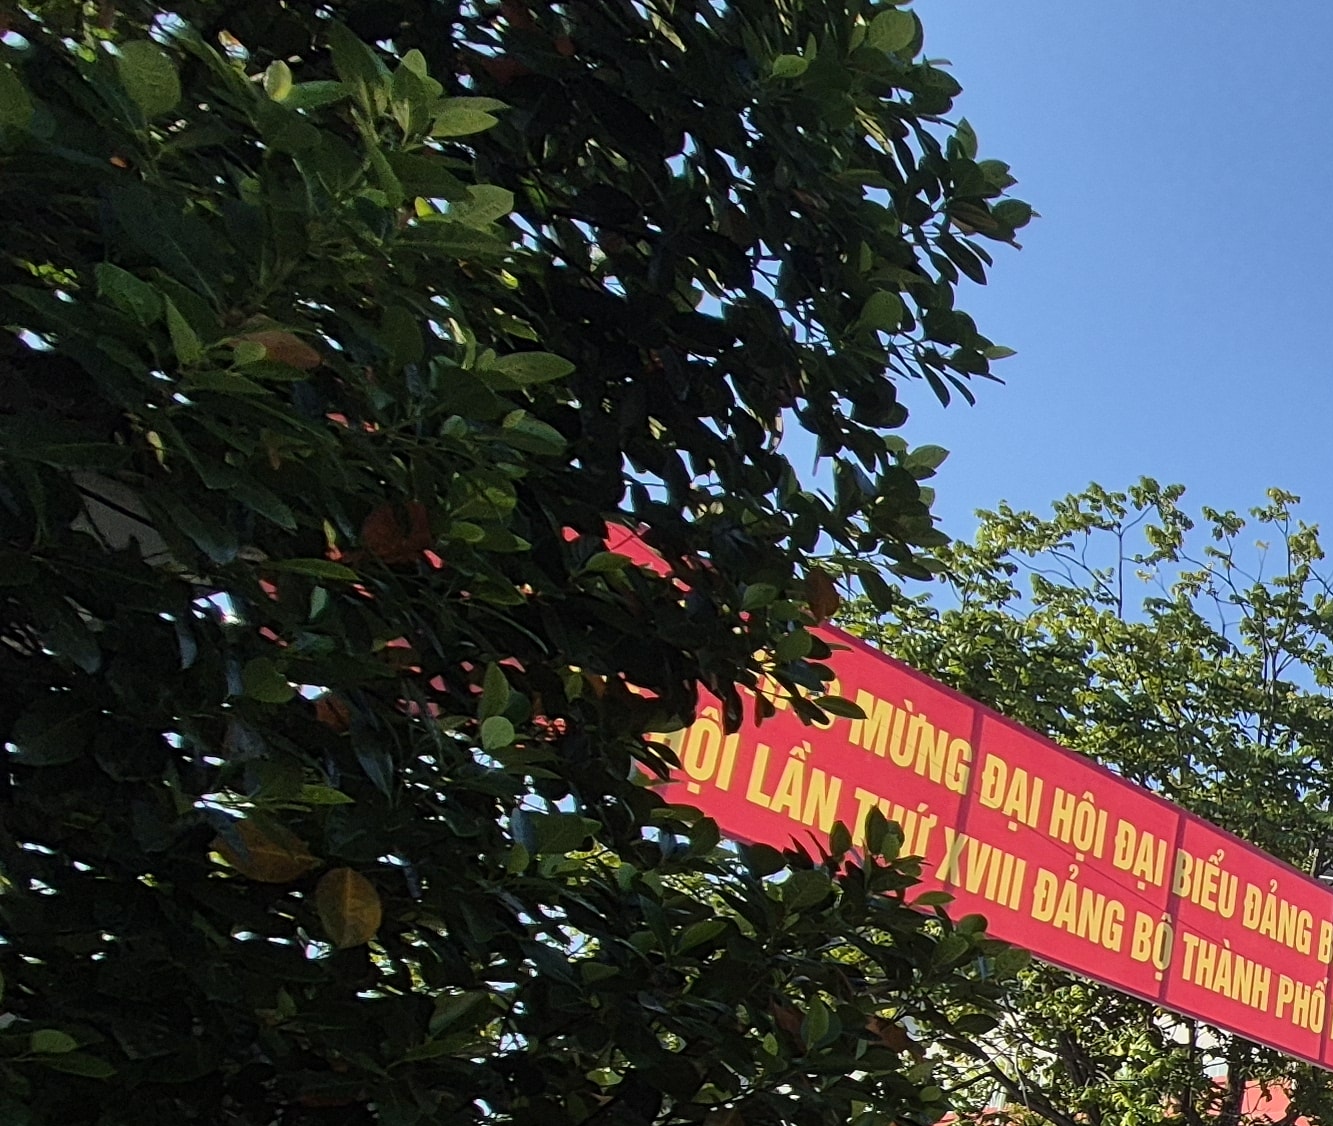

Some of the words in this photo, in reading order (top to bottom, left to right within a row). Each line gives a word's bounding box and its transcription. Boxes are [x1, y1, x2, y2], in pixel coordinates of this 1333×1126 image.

[745, 739, 843, 835] LẦN
[934, 826, 1027, 912] XVIII
[1030, 863, 1126, 953] ĐẢNG
[1130, 910, 1174, 982] BỘ
[1181, 931, 1272, 1013] THÀNH
[1275, 973, 1328, 1035] PHỐ
[848, 688, 973, 796] MỪNG
[979, 753, 1044, 832] ĐẠI
[1048, 787, 1108, 862] HỘI
[1112, 818, 1168, 891] ĐẠI
[1172, 848, 1239, 919] BIỂU
[1242, 878, 1314, 956] ĐẢNG
